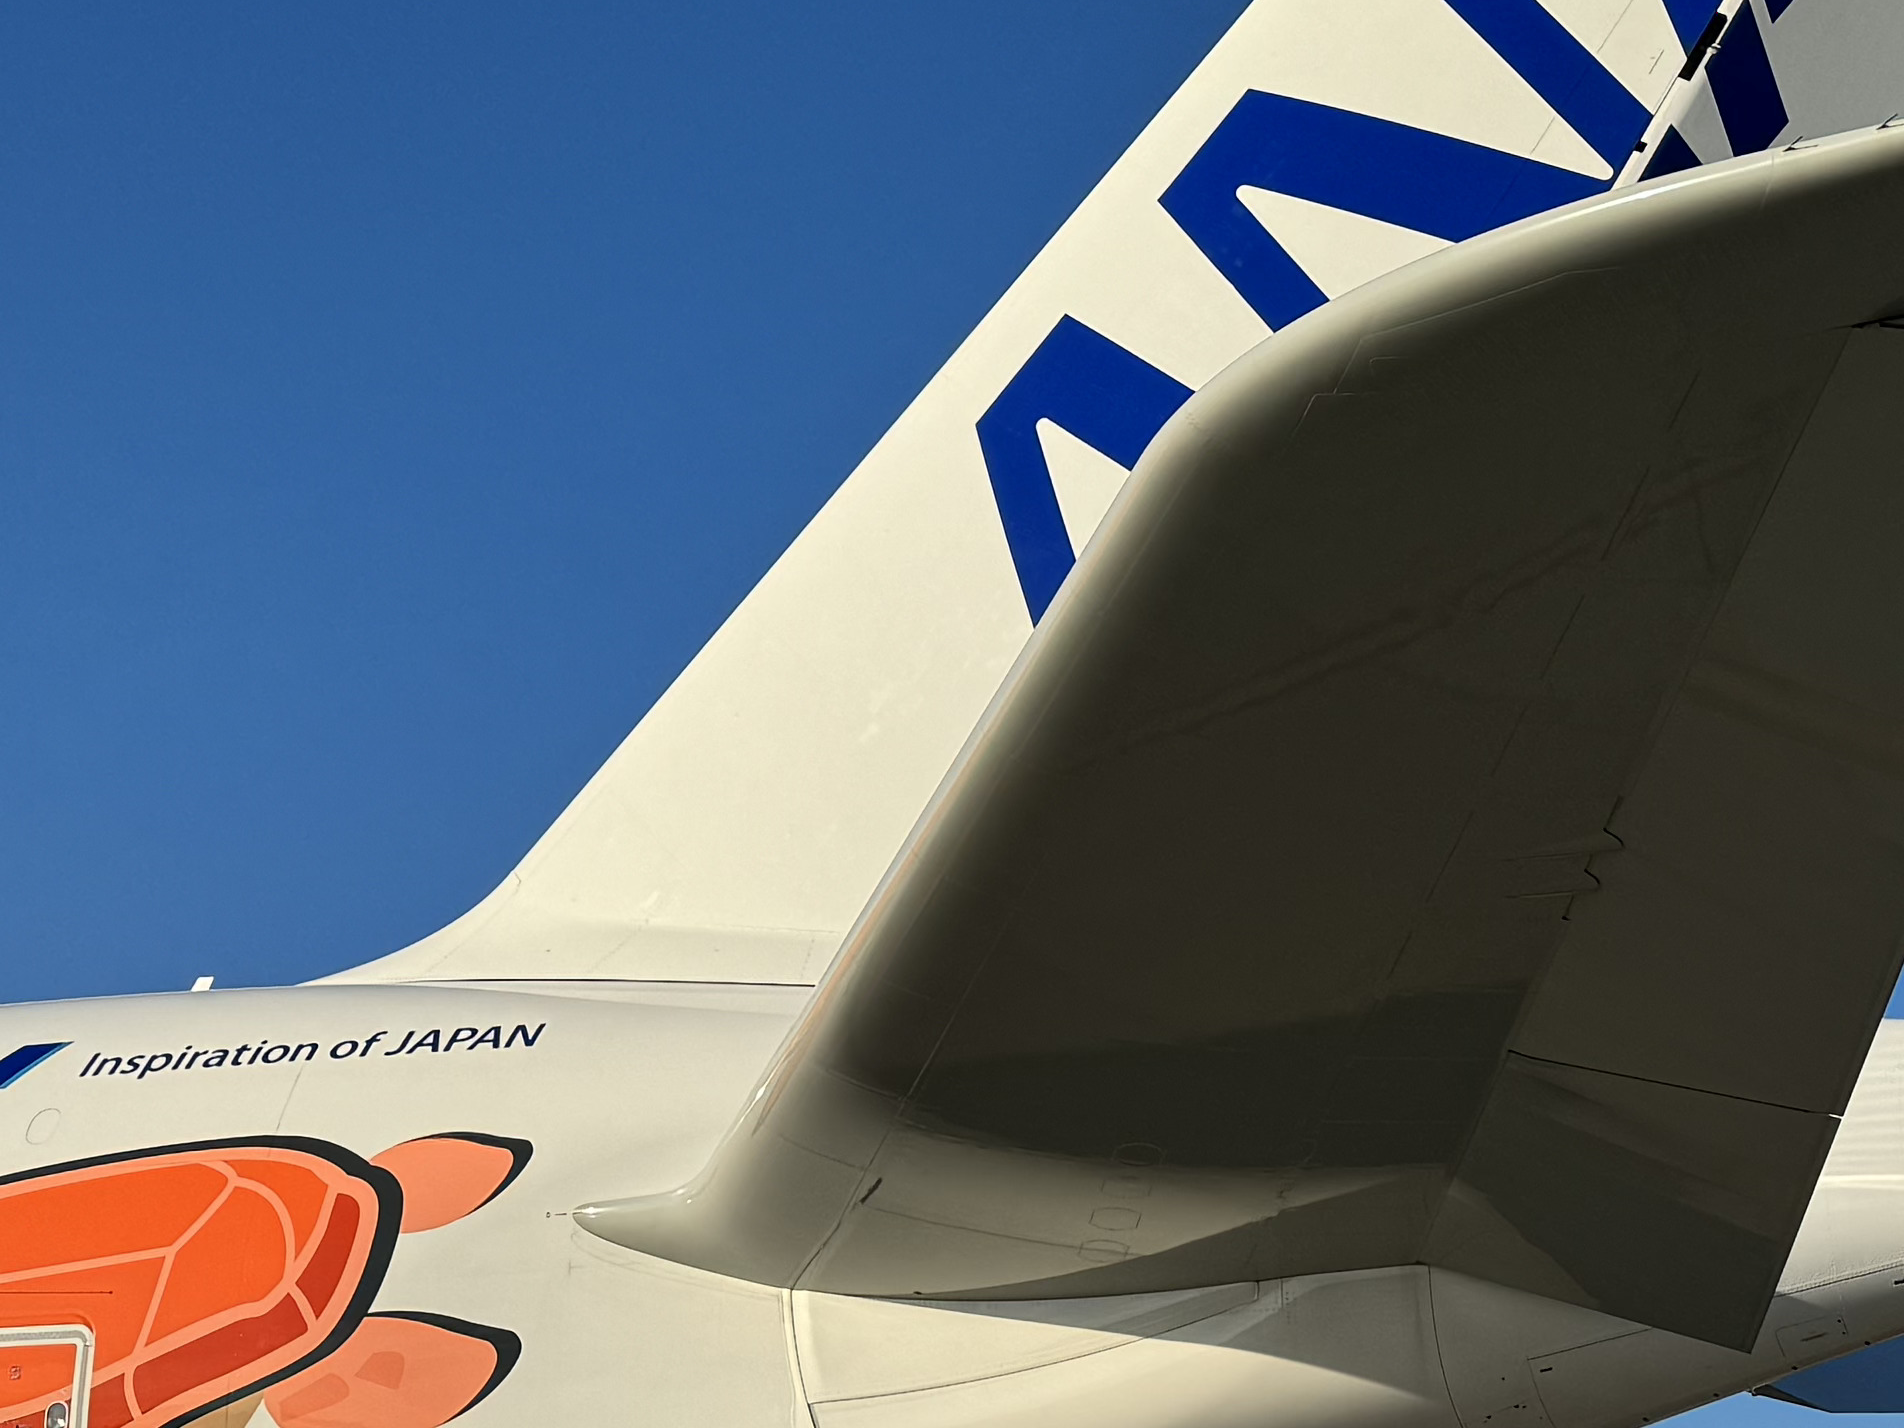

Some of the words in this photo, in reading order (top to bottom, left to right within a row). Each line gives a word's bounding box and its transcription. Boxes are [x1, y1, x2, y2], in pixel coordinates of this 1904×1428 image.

[79, 1038, 318, 1079] Inspiration
[328, 1030, 389, 1059] of
[384, 1022, 547, 1057] JAPAN
